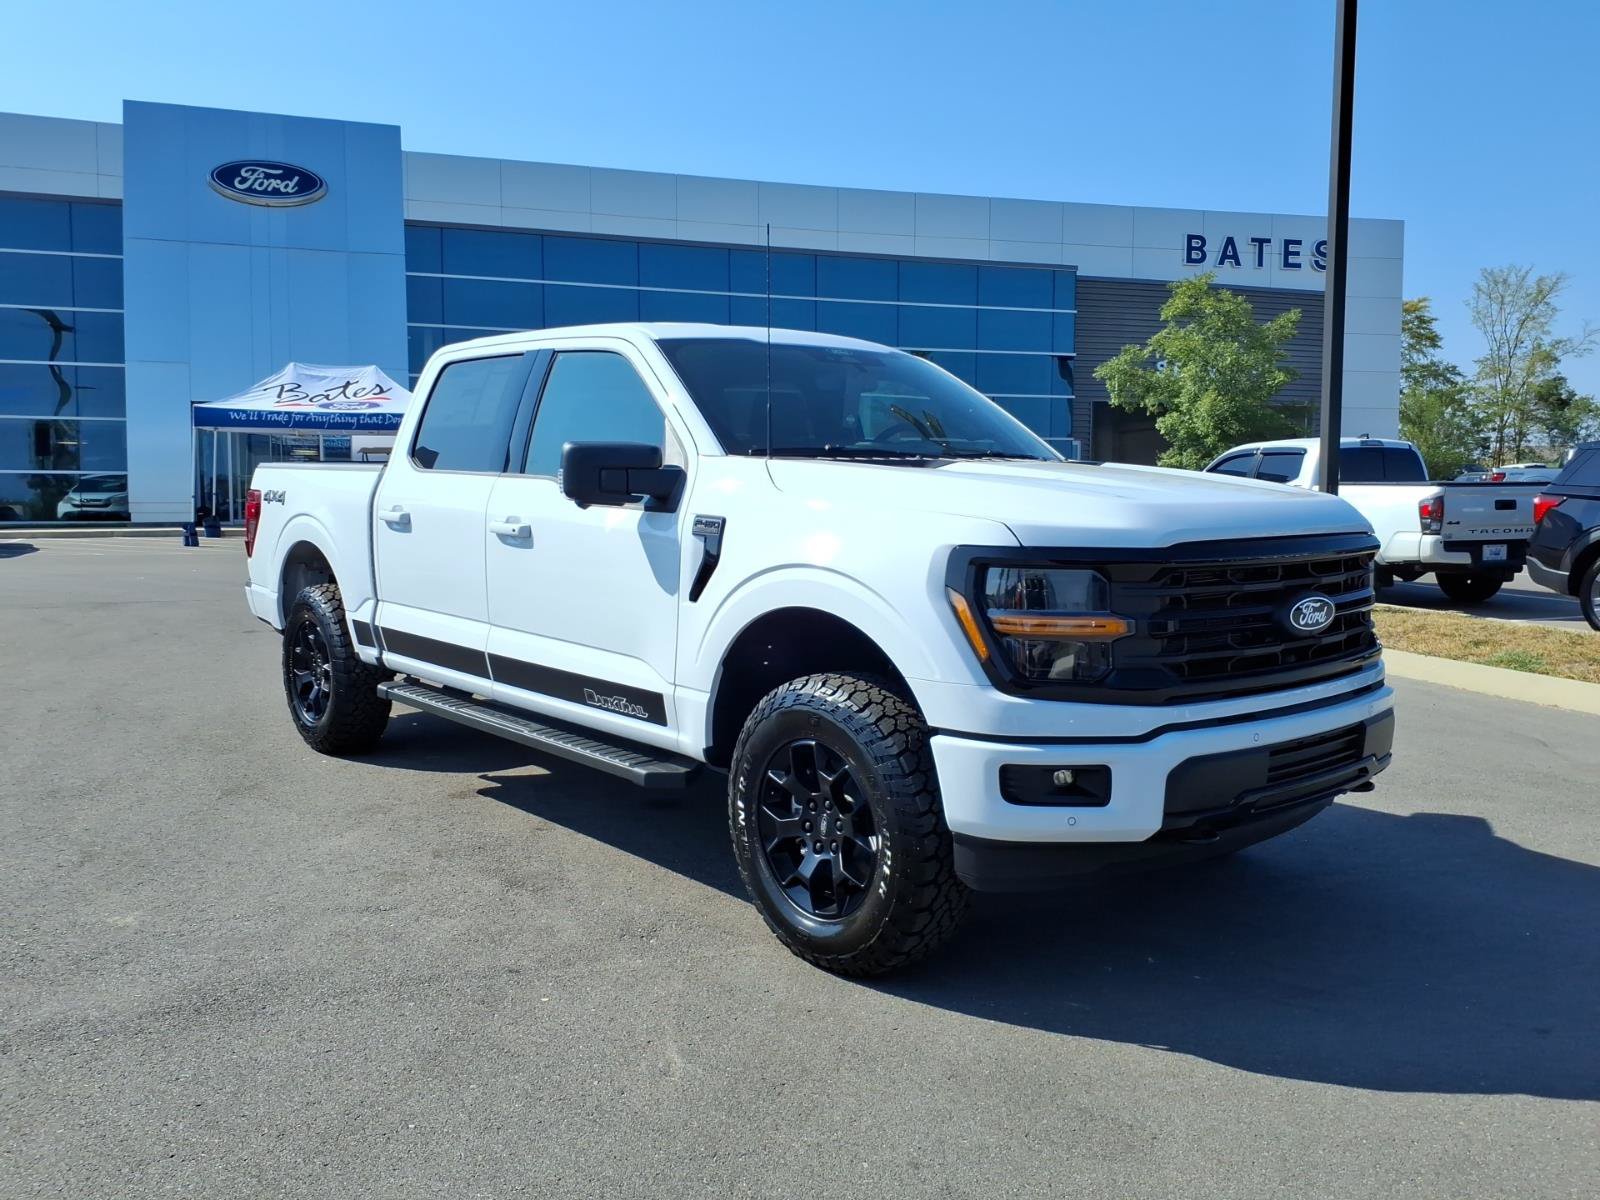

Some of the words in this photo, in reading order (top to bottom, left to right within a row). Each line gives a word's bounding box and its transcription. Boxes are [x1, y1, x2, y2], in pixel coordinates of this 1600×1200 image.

[234, 166, 300, 193] Ford
[1184, 233, 1328, 272] BATES
[263, 379, 393, 404] Bates
[228, 411, 259, 421] We'll
[261, 411, 289, 425] Trade
[289, 412, 305, 428] for
[305, 411, 358, 430] Anything
[360, 411, 383, 425] that
[1299, 602, 1329, 625] Ford
